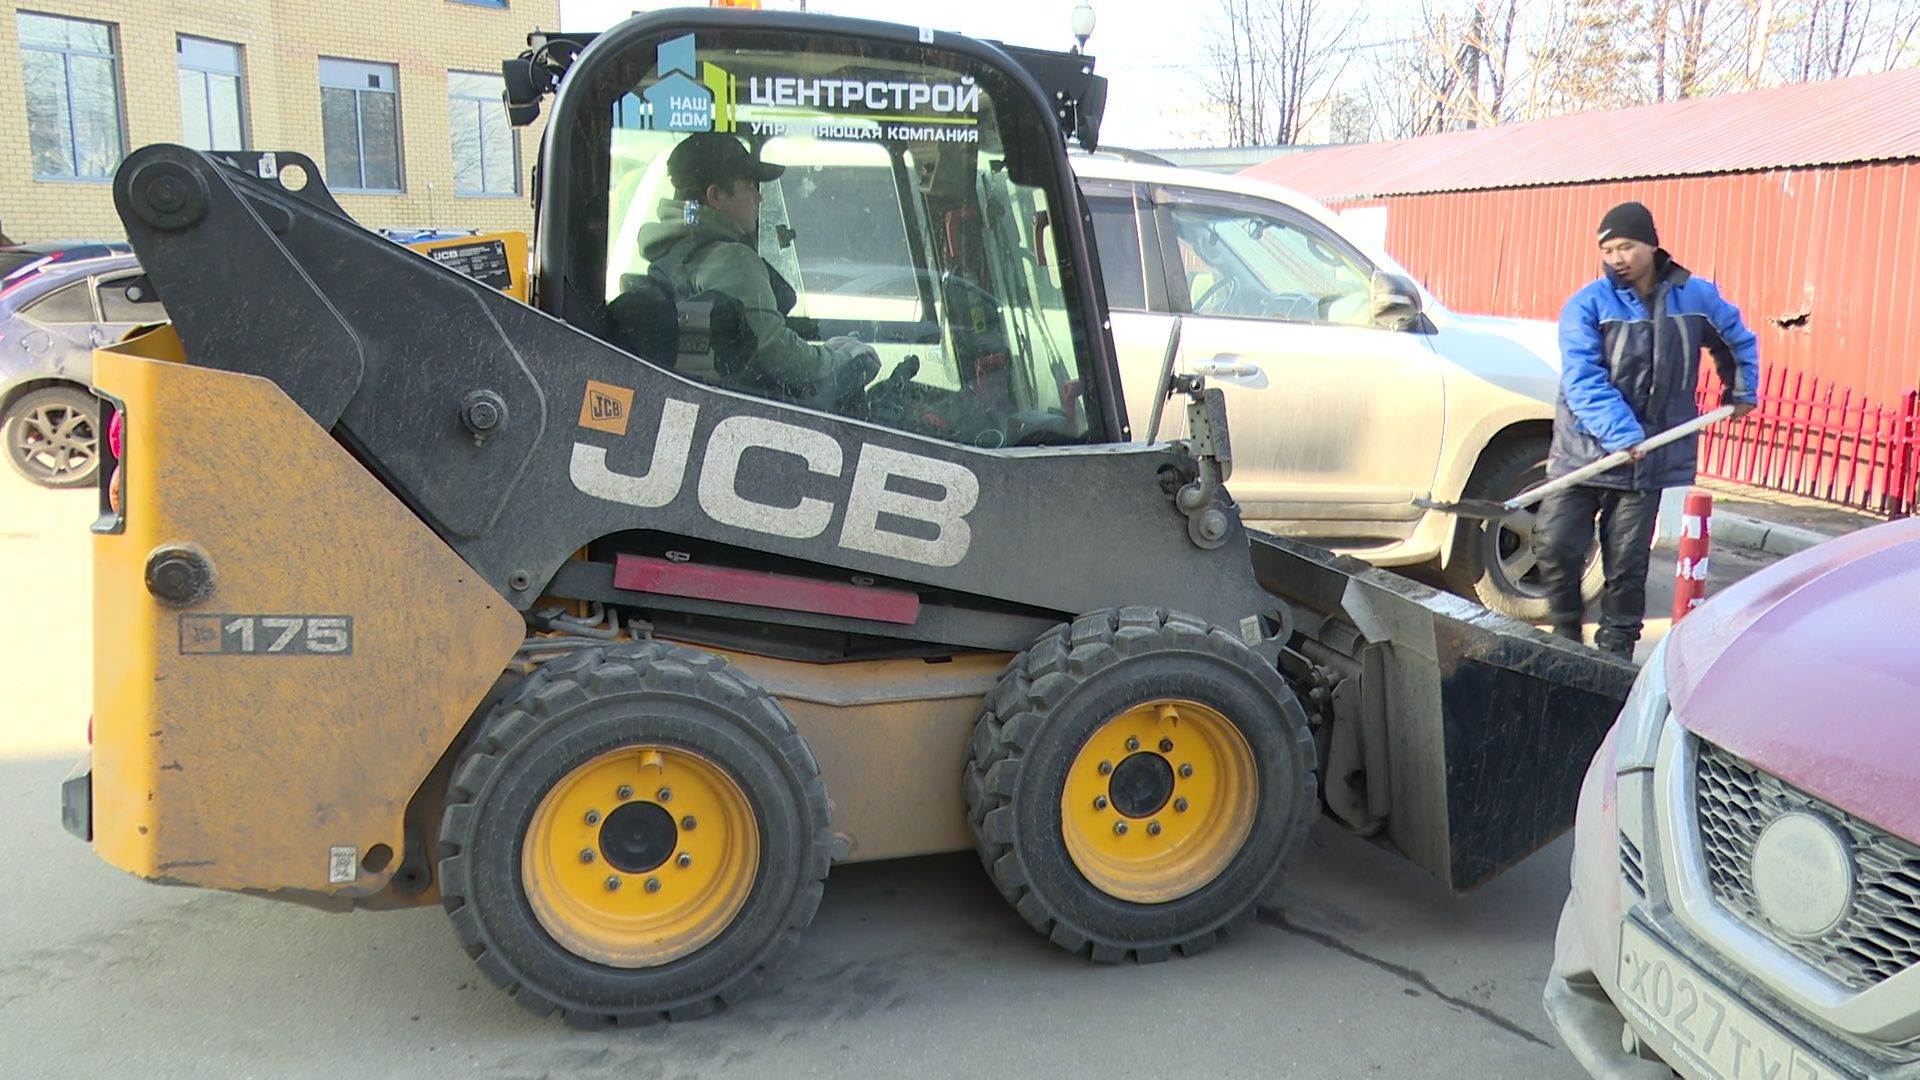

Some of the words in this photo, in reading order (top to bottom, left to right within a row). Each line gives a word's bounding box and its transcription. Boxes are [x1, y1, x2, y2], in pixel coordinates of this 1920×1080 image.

[669, 96, 708, 111] НАШ
[749, 76, 979, 113] ЦЕНТРСТРОЙ
[669, 113, 708, 128] ДОМ
[750, 122, 882, 140] УПРАЛЯЮЩАЯ
[886, 126, 979, 143] КОМПАНИЯ
[592, 393, 622, 419] JCB
[569, 398, 980, 568] JCB
[224, 617, 348, 653] 175
